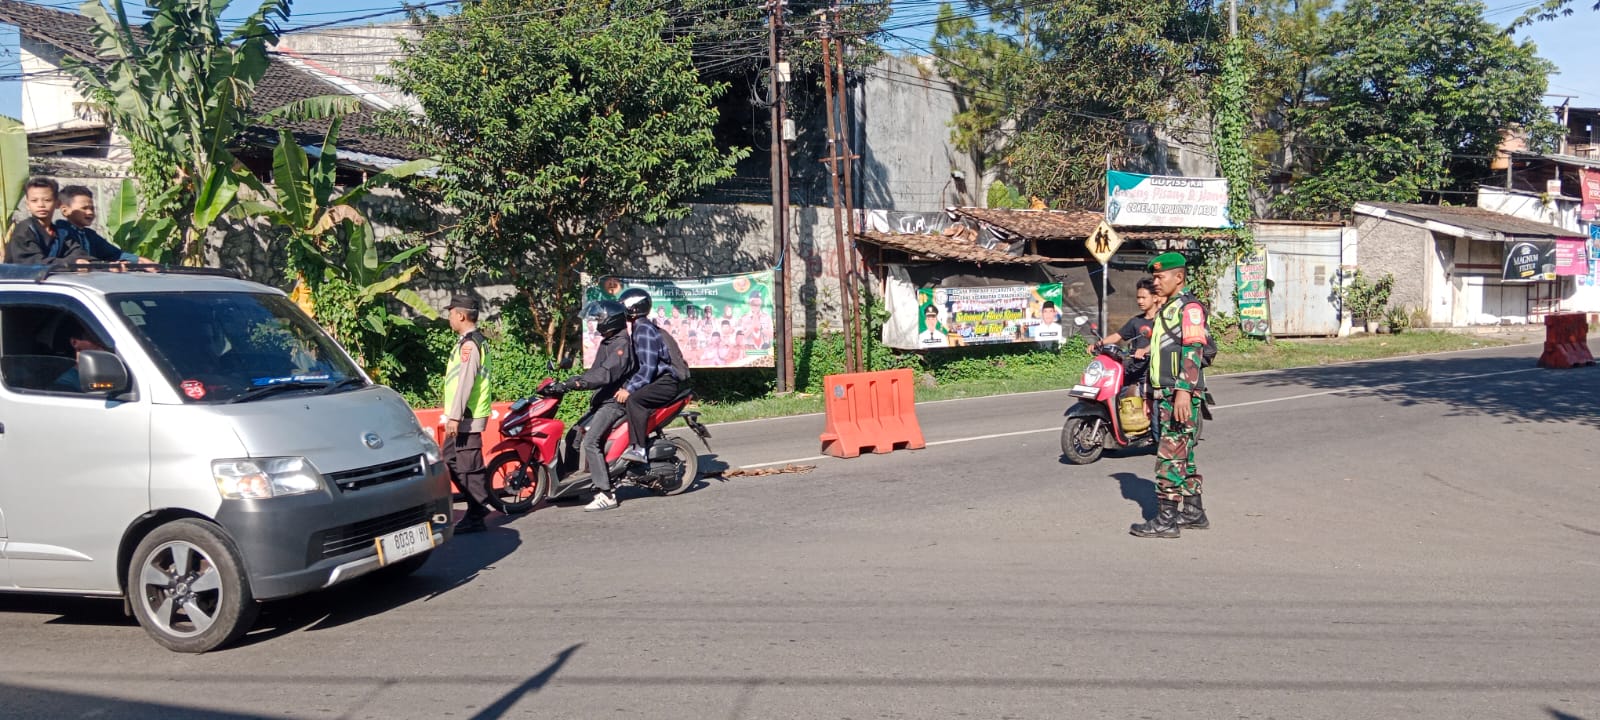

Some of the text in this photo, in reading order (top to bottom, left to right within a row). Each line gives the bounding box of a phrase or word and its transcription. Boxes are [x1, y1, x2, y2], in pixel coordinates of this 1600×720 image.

[1126, 202, 1158, 214] COKELAT
[1198, 205, 1218, 217] KEJU
[1513, 253, 1539, 266] MAGNUM
[676, 288, 691, 299] Raya
[956, 310, 984, 322] Selamat
[986, 309, 1003, 320] Hari
[394, 530, 415, 549] 8038
